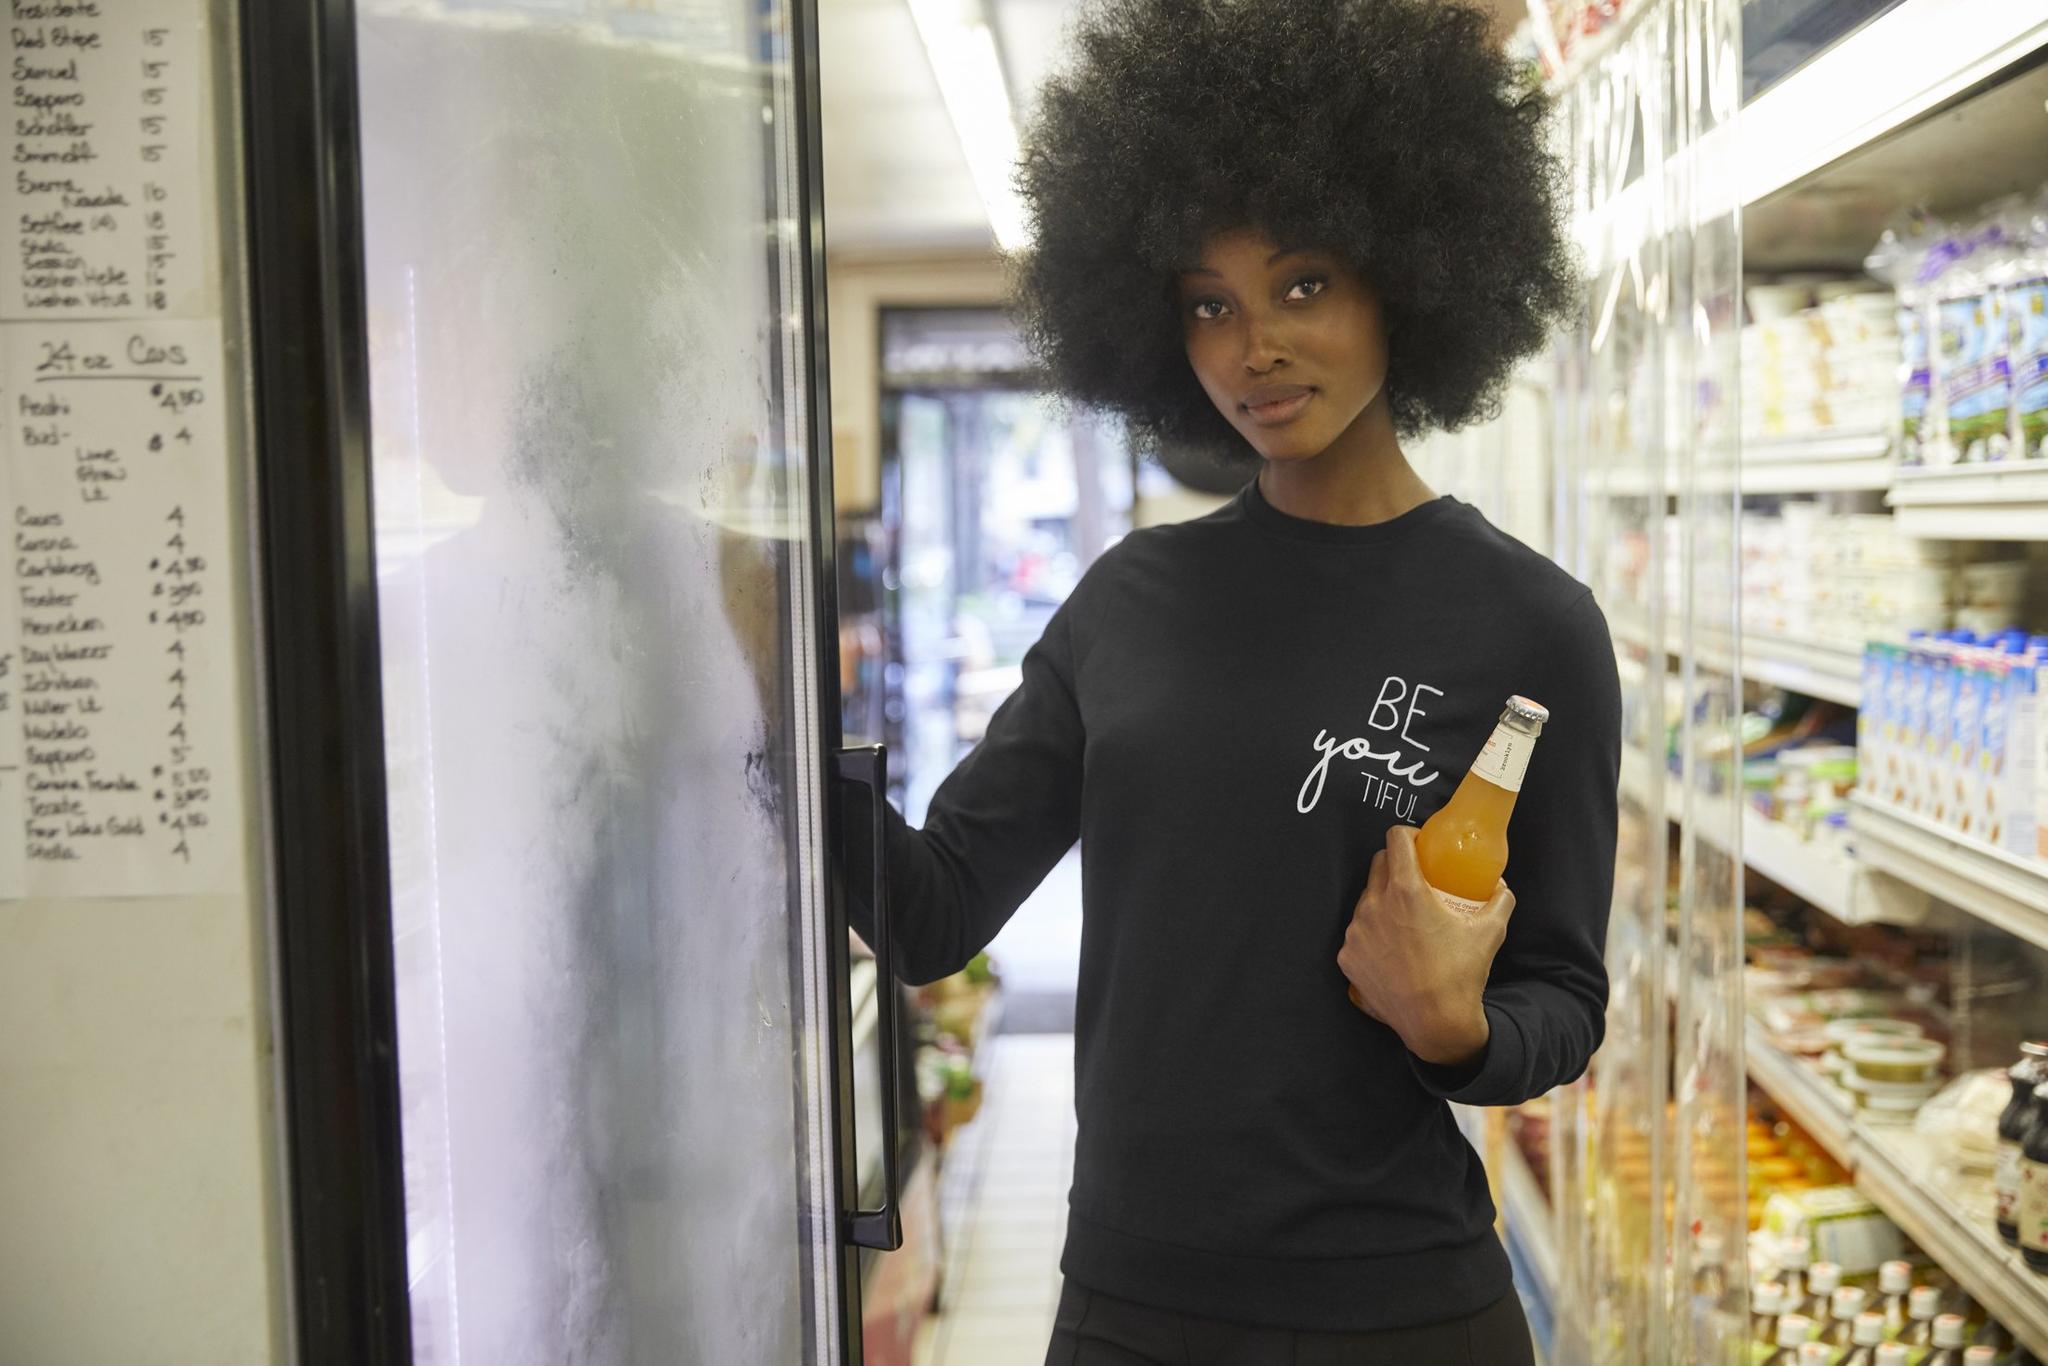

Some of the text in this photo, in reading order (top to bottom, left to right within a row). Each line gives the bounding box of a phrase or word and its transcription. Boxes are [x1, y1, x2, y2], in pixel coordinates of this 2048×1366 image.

[1368, 676, 1444, 752] BE
[1296, 728, 1439, 814] you
[1361, 771, 1418, 825] TIFUL
